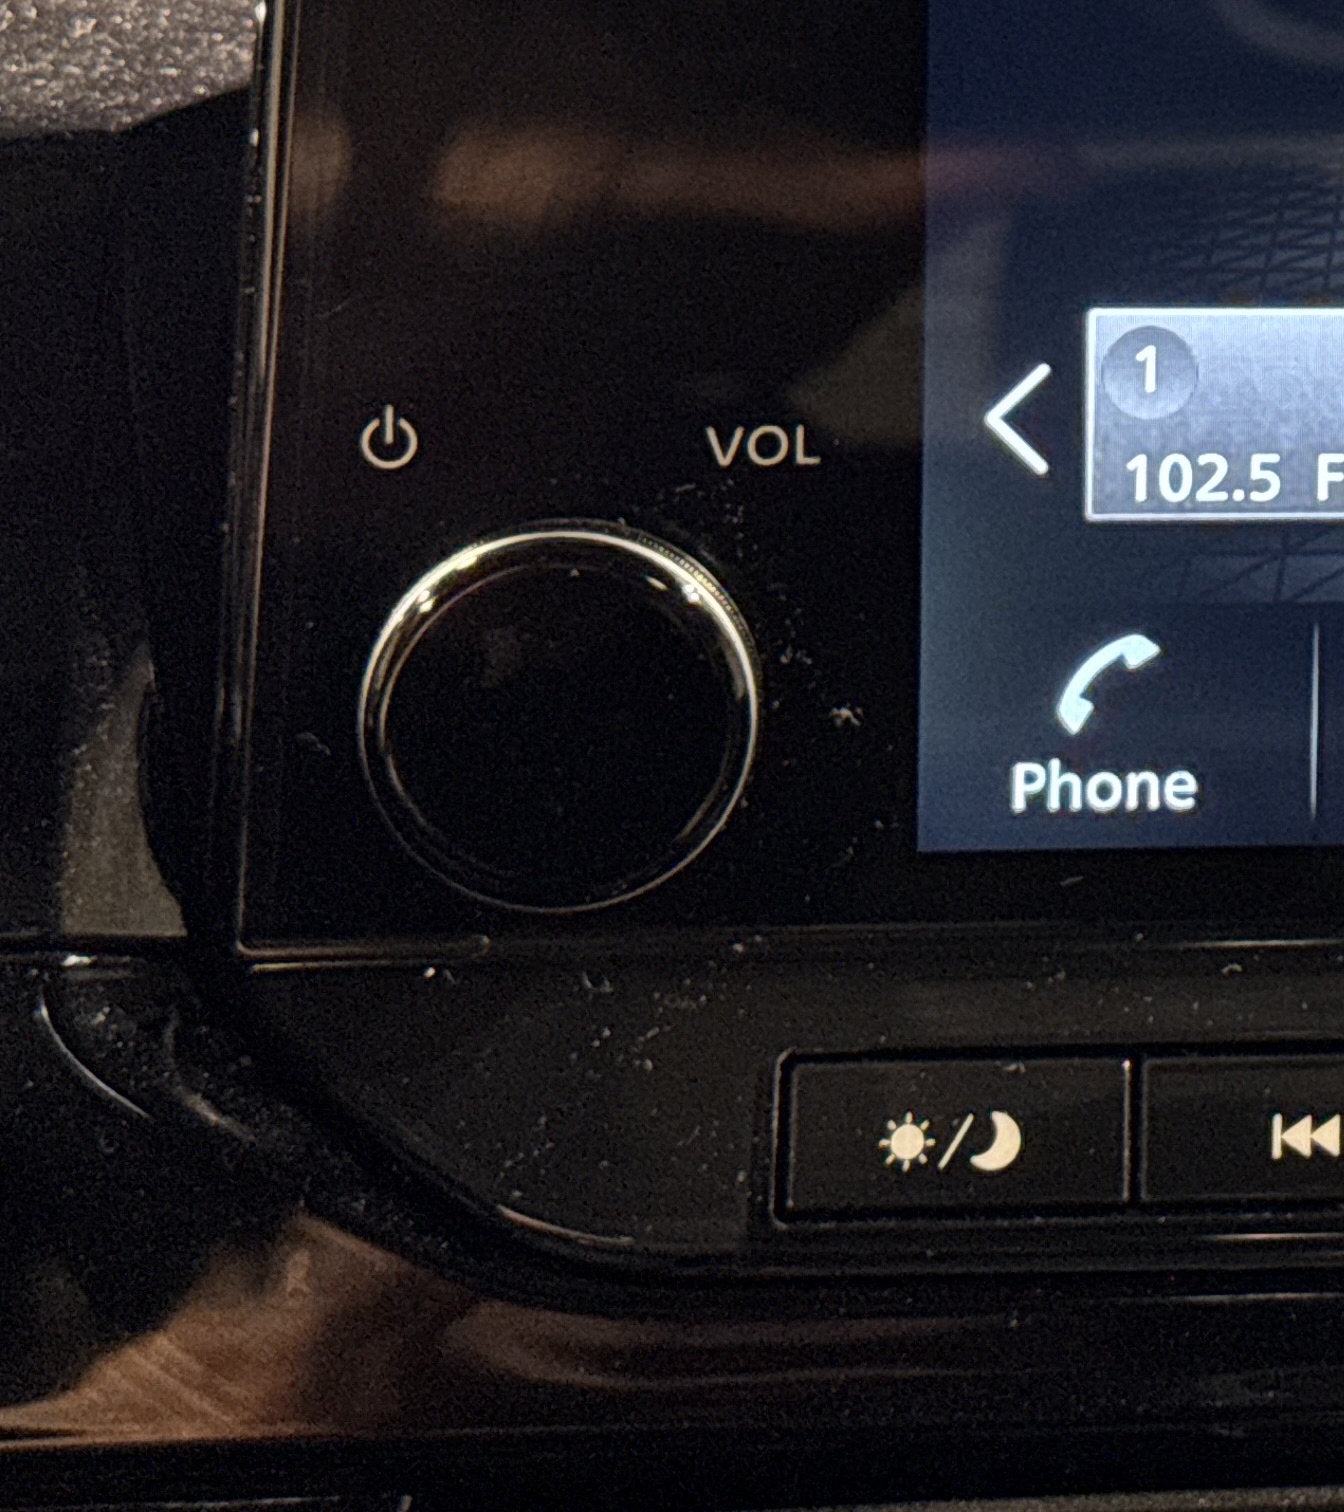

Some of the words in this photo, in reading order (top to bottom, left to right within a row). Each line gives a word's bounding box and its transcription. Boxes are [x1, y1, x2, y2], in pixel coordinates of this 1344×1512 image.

[1134, 344, 1158, 394] 1
[705, 424, 822, 468] VOL
[1126, 452, 1281, 503] 102.5
[1010, 758, 1199, 812] Phone
